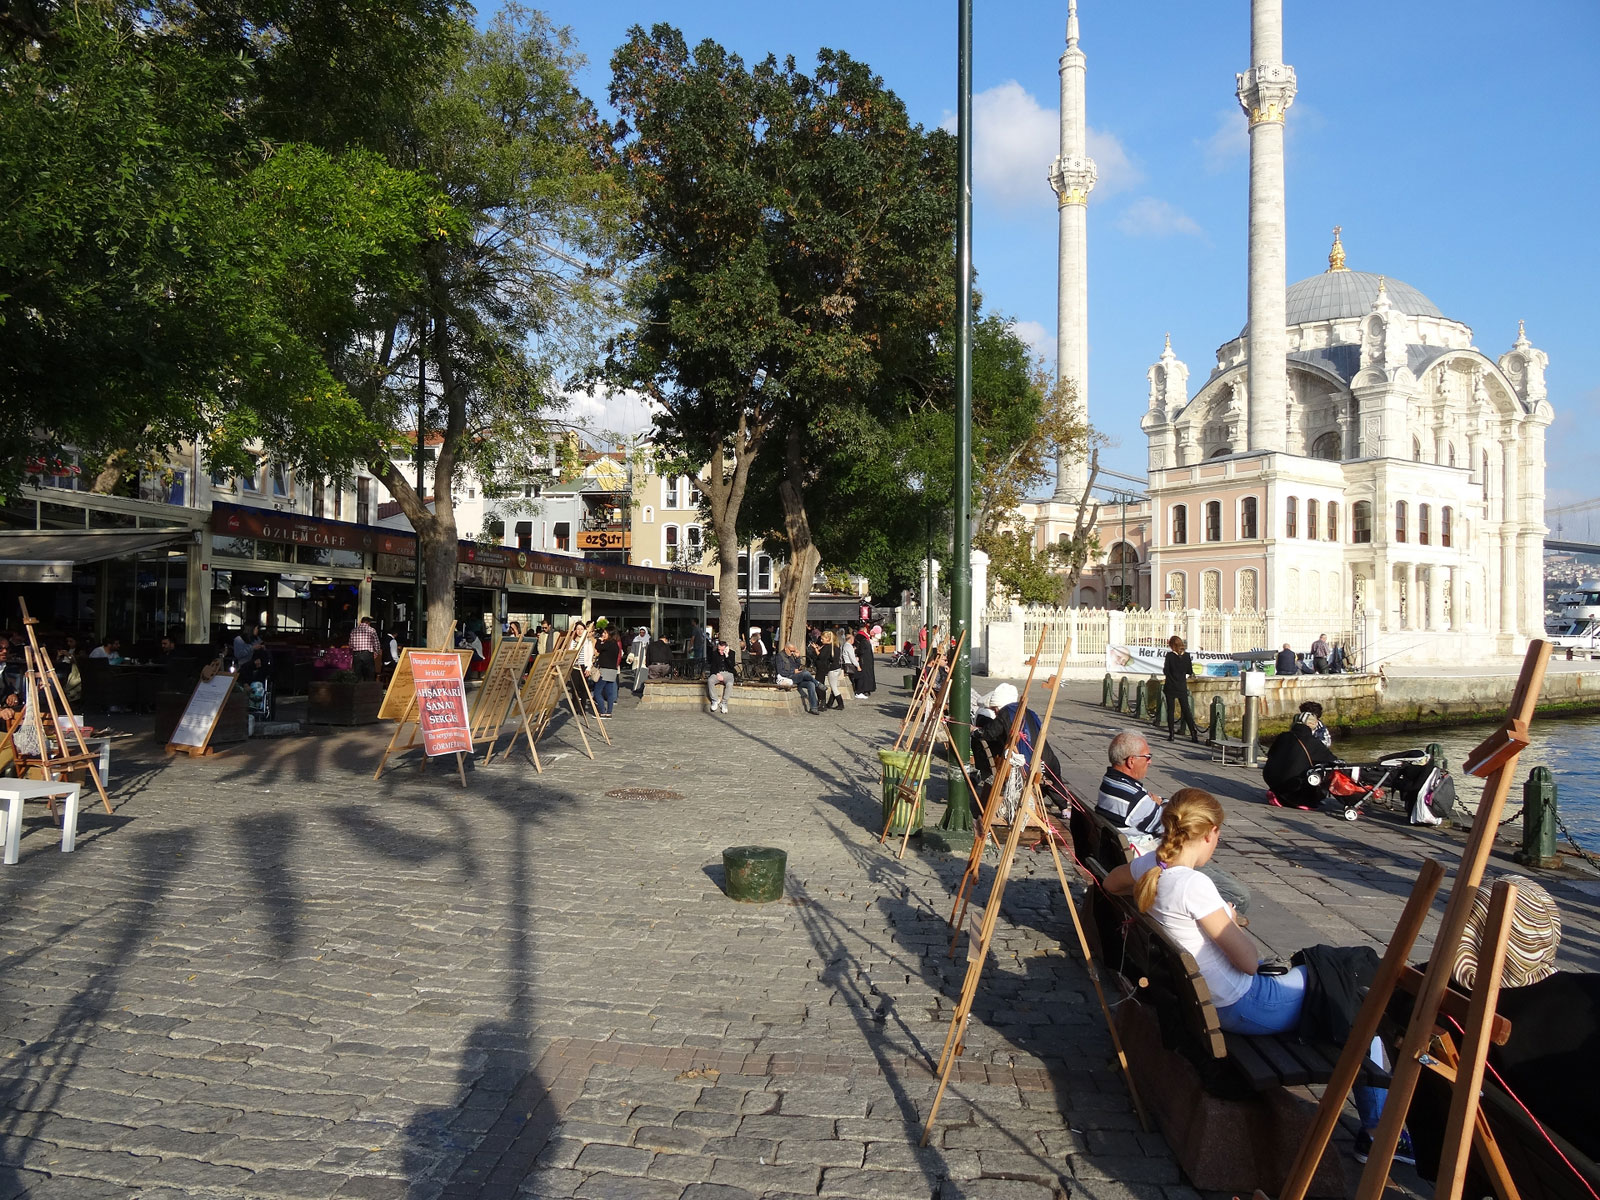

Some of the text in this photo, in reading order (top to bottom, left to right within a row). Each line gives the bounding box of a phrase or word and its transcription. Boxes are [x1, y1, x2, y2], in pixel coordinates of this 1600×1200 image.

[263, 524, 345, 546] ÖZLEM CAFE
[1139, 647, 1155, 657] Her
